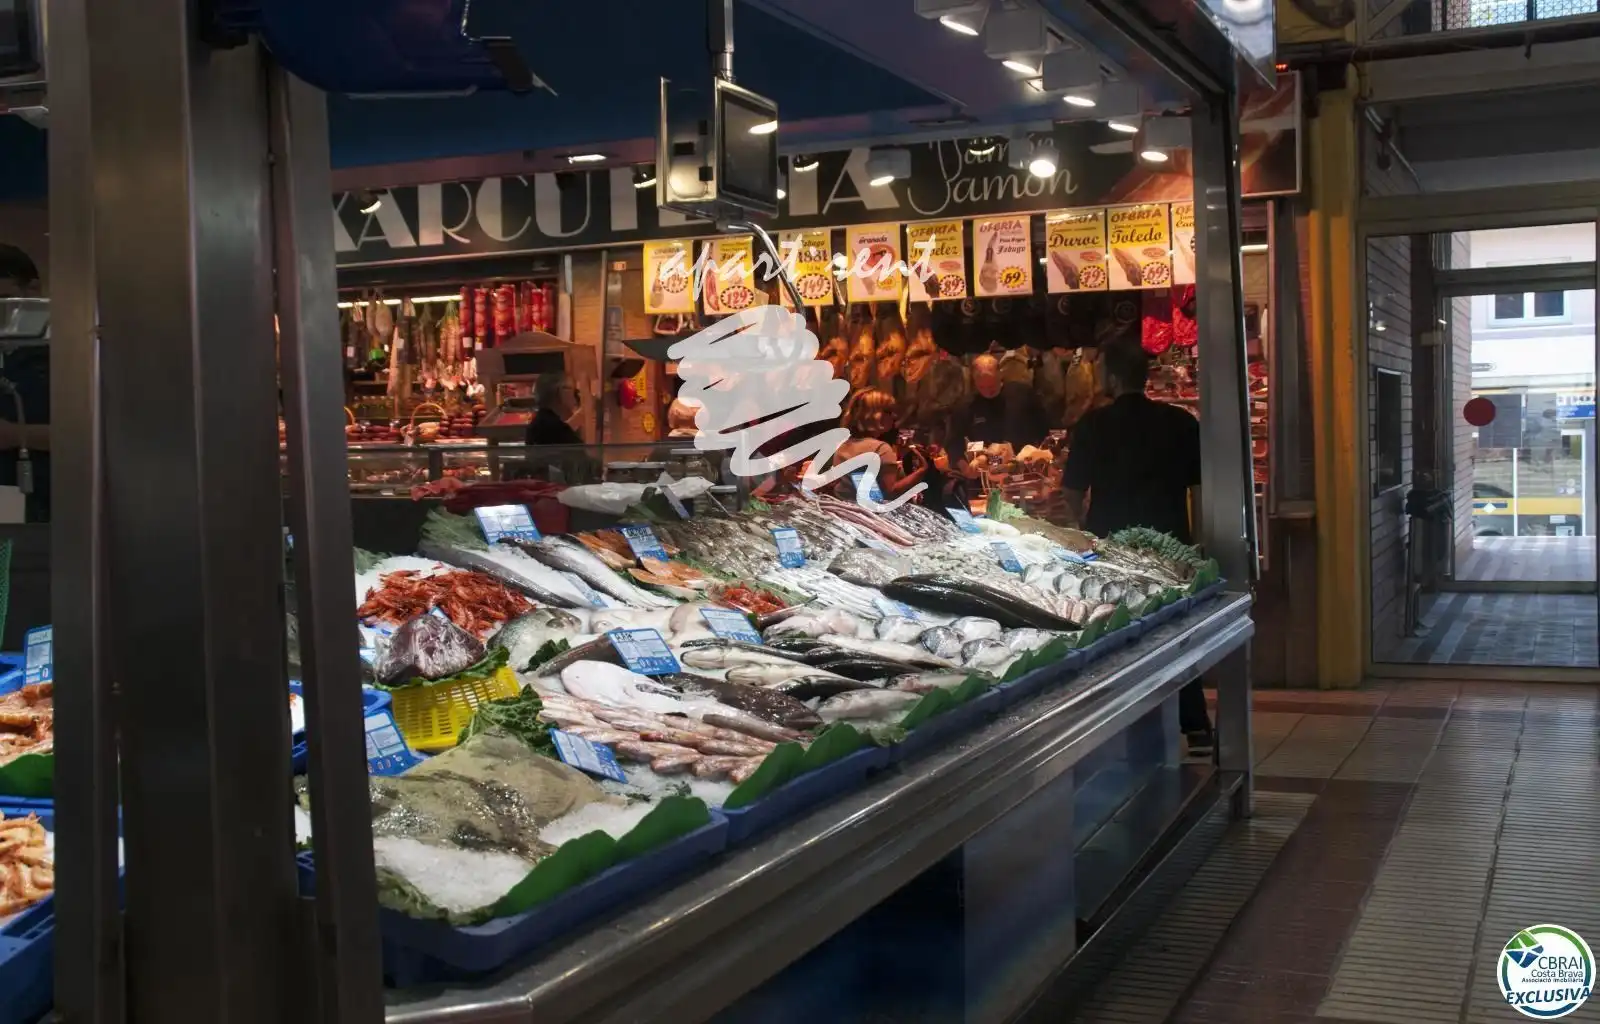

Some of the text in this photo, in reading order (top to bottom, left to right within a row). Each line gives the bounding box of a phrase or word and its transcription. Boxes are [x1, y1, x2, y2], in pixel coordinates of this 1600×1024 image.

[1111, 208, 1162, 223] OFERTA
[1175, 205, 1193, 216] OF
[911, 223, 958, 238] OFERTA
[980, 219, 1022, 232] OFERTA
[1048, 233, 1100, 248] Duroc
[1110, 227, 1162, 245] Toledo
[1084, 269, 1100, 285] 79
[1147, 266, 1164, 281] 69
[802, 277, 824, 295] 149
[944, 278, 960, 292] 89
[727, 289, 748, 304] 129
